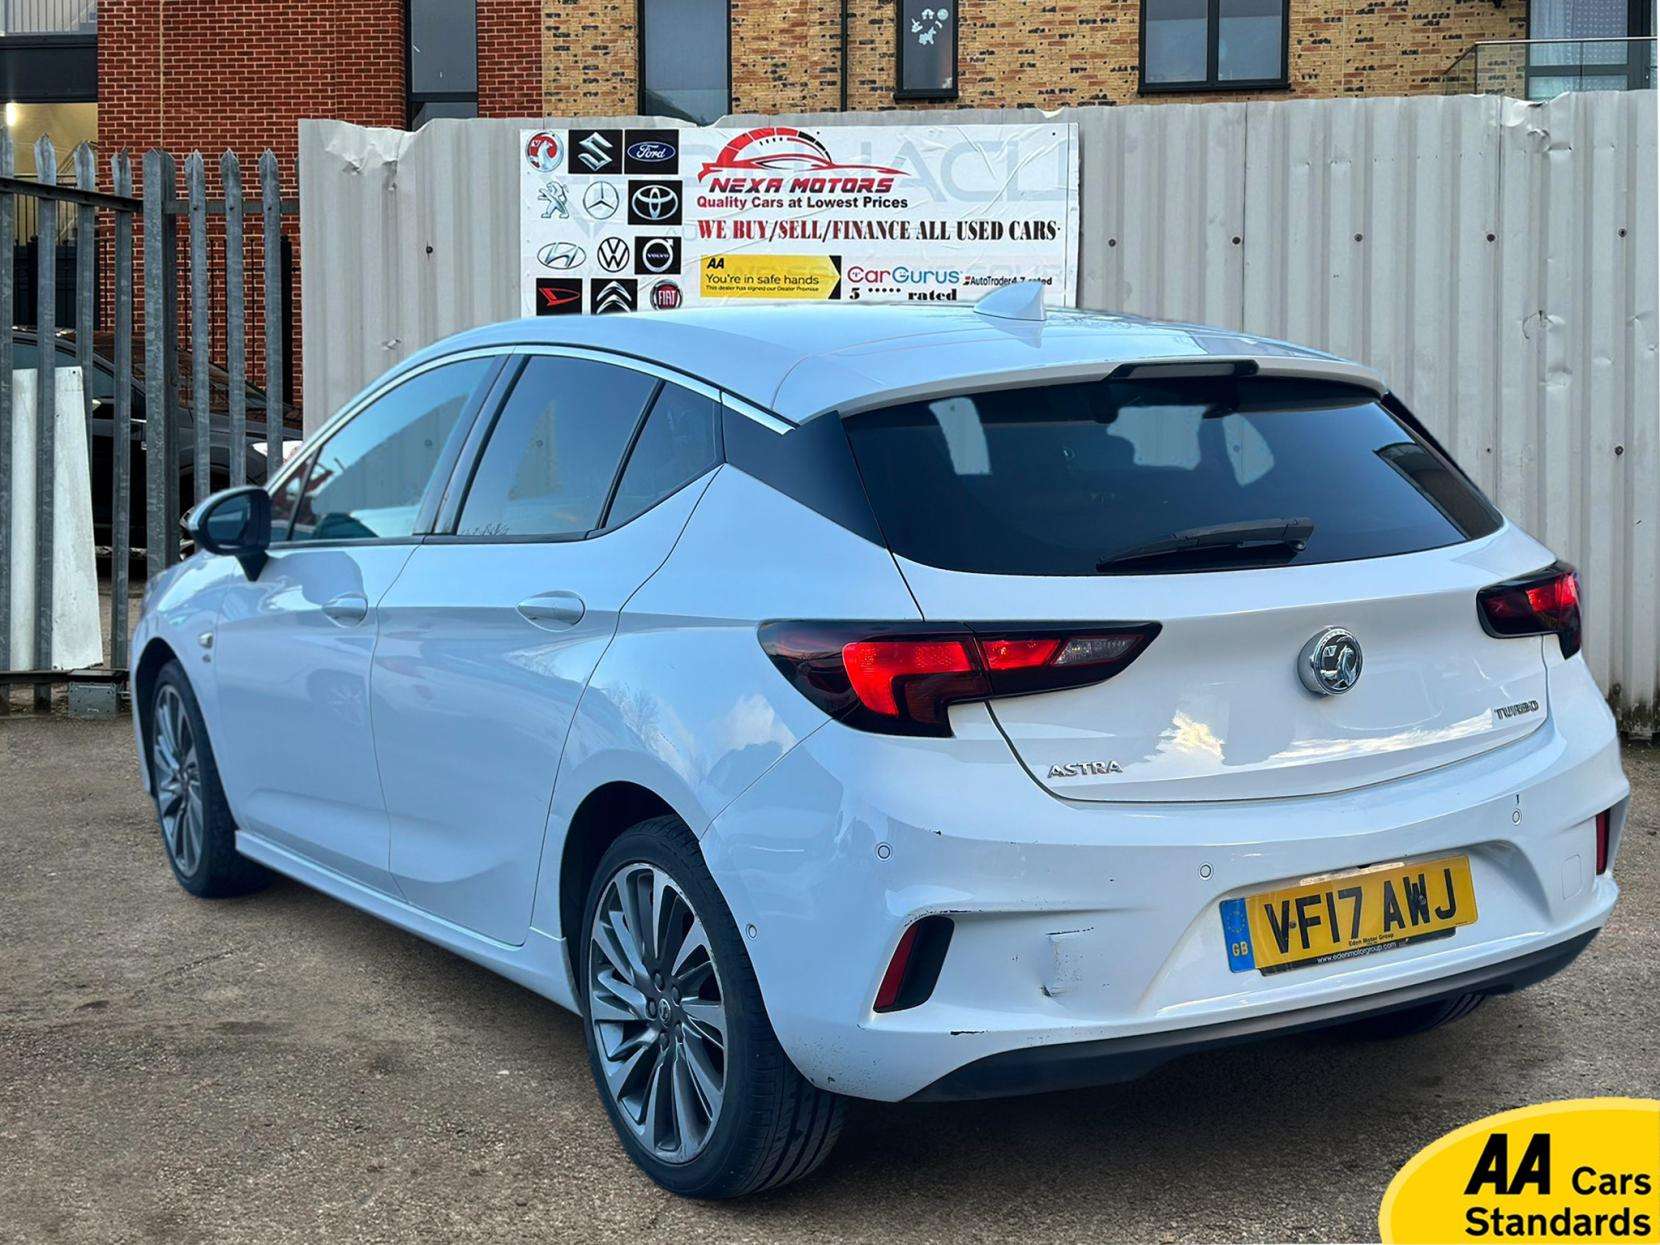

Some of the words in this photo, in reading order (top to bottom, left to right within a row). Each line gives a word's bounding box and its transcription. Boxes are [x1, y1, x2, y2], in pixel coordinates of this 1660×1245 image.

[636, 143, 666, 158] Ford
[709, 178, 784, 193] NEXA
[789, 178, 894, 193] MOTORS
[697, 196, 747, 209] Quality
[752, 196, 784, 208] Cars
[788, 197, 802, 208] at
[807, 196, 859, 208] Lowest
[863, 196, 908, 208] Prices
[698, 220, 726, 240] WE
[732, 219, 910, 243] BUY/SELL/FINANCE
[917, 221, 950, 240] ALL
[956, 221, 1003, 240] USED
[707, 257, 725, 269] AA
[706, 274, 741, 284] You're
[744, 274, 754, 284] in
[757, 274, 780, 285] safe
[784, 275, 819, 285] hands
[847, 266, 960, 284] CarGurus
[657, 288, 677, 306] FIAT
[849, 287, 860, 300] 5
[908, 288, 957, 301] rated
[1494, 700, 1539, 719] TURBO
[1047, 760, 1123, 778] ASTRA
[1264, 885, 1364, 955] VF17
[1383, 867, 1458, 933] AWJ
[1232, 942, 1249, 957] GB
